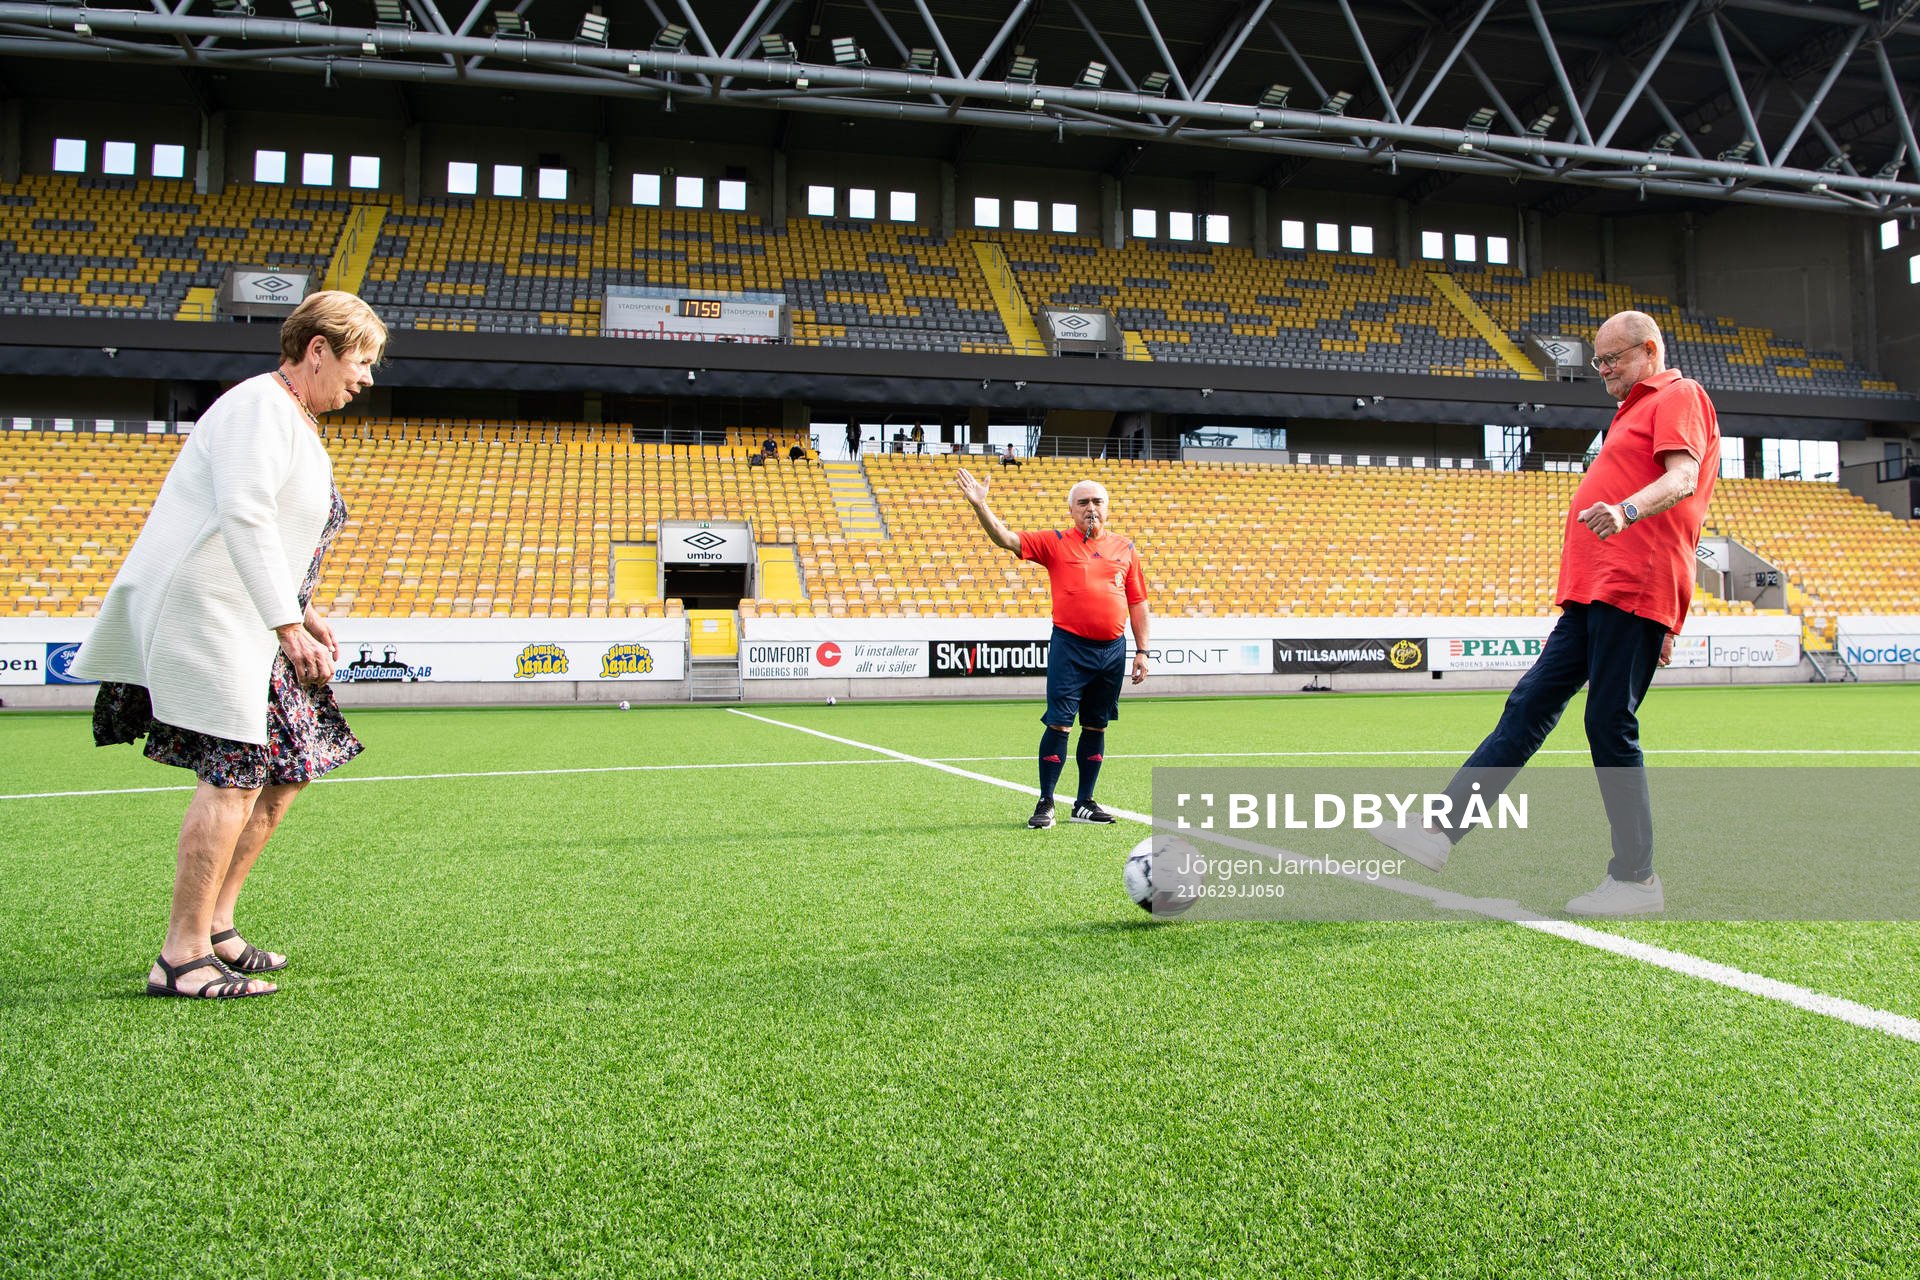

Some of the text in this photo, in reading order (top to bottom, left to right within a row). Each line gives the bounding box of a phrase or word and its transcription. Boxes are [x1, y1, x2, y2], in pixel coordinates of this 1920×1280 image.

[618, 303, 664, 311] STADSPORTEN
[723, 308, 768, 316] STADSPORTEN
[687, 552, 722, 560] umbro
[523, 643, 565, 659] Blomster
[609, 643, 650, 659] Blomster
[750, 646, 811, 663] COMFORT
[854, 645, 920, 657] Vi installerar
[1280, 649, 1292, 662] VI
[1295, 649, 1385, 662] TILLSAMMANS
[1461, 639, 1541, 656] PEAB
[1714, 646, 1774, 662] ProFlow
[514, 654, 569, 678] Landet
[600, 654, 653, 678] Landet
[937, 642, 1050, 674] Skyltprodu
[856, 661, 917, 675] allt vi säljer
